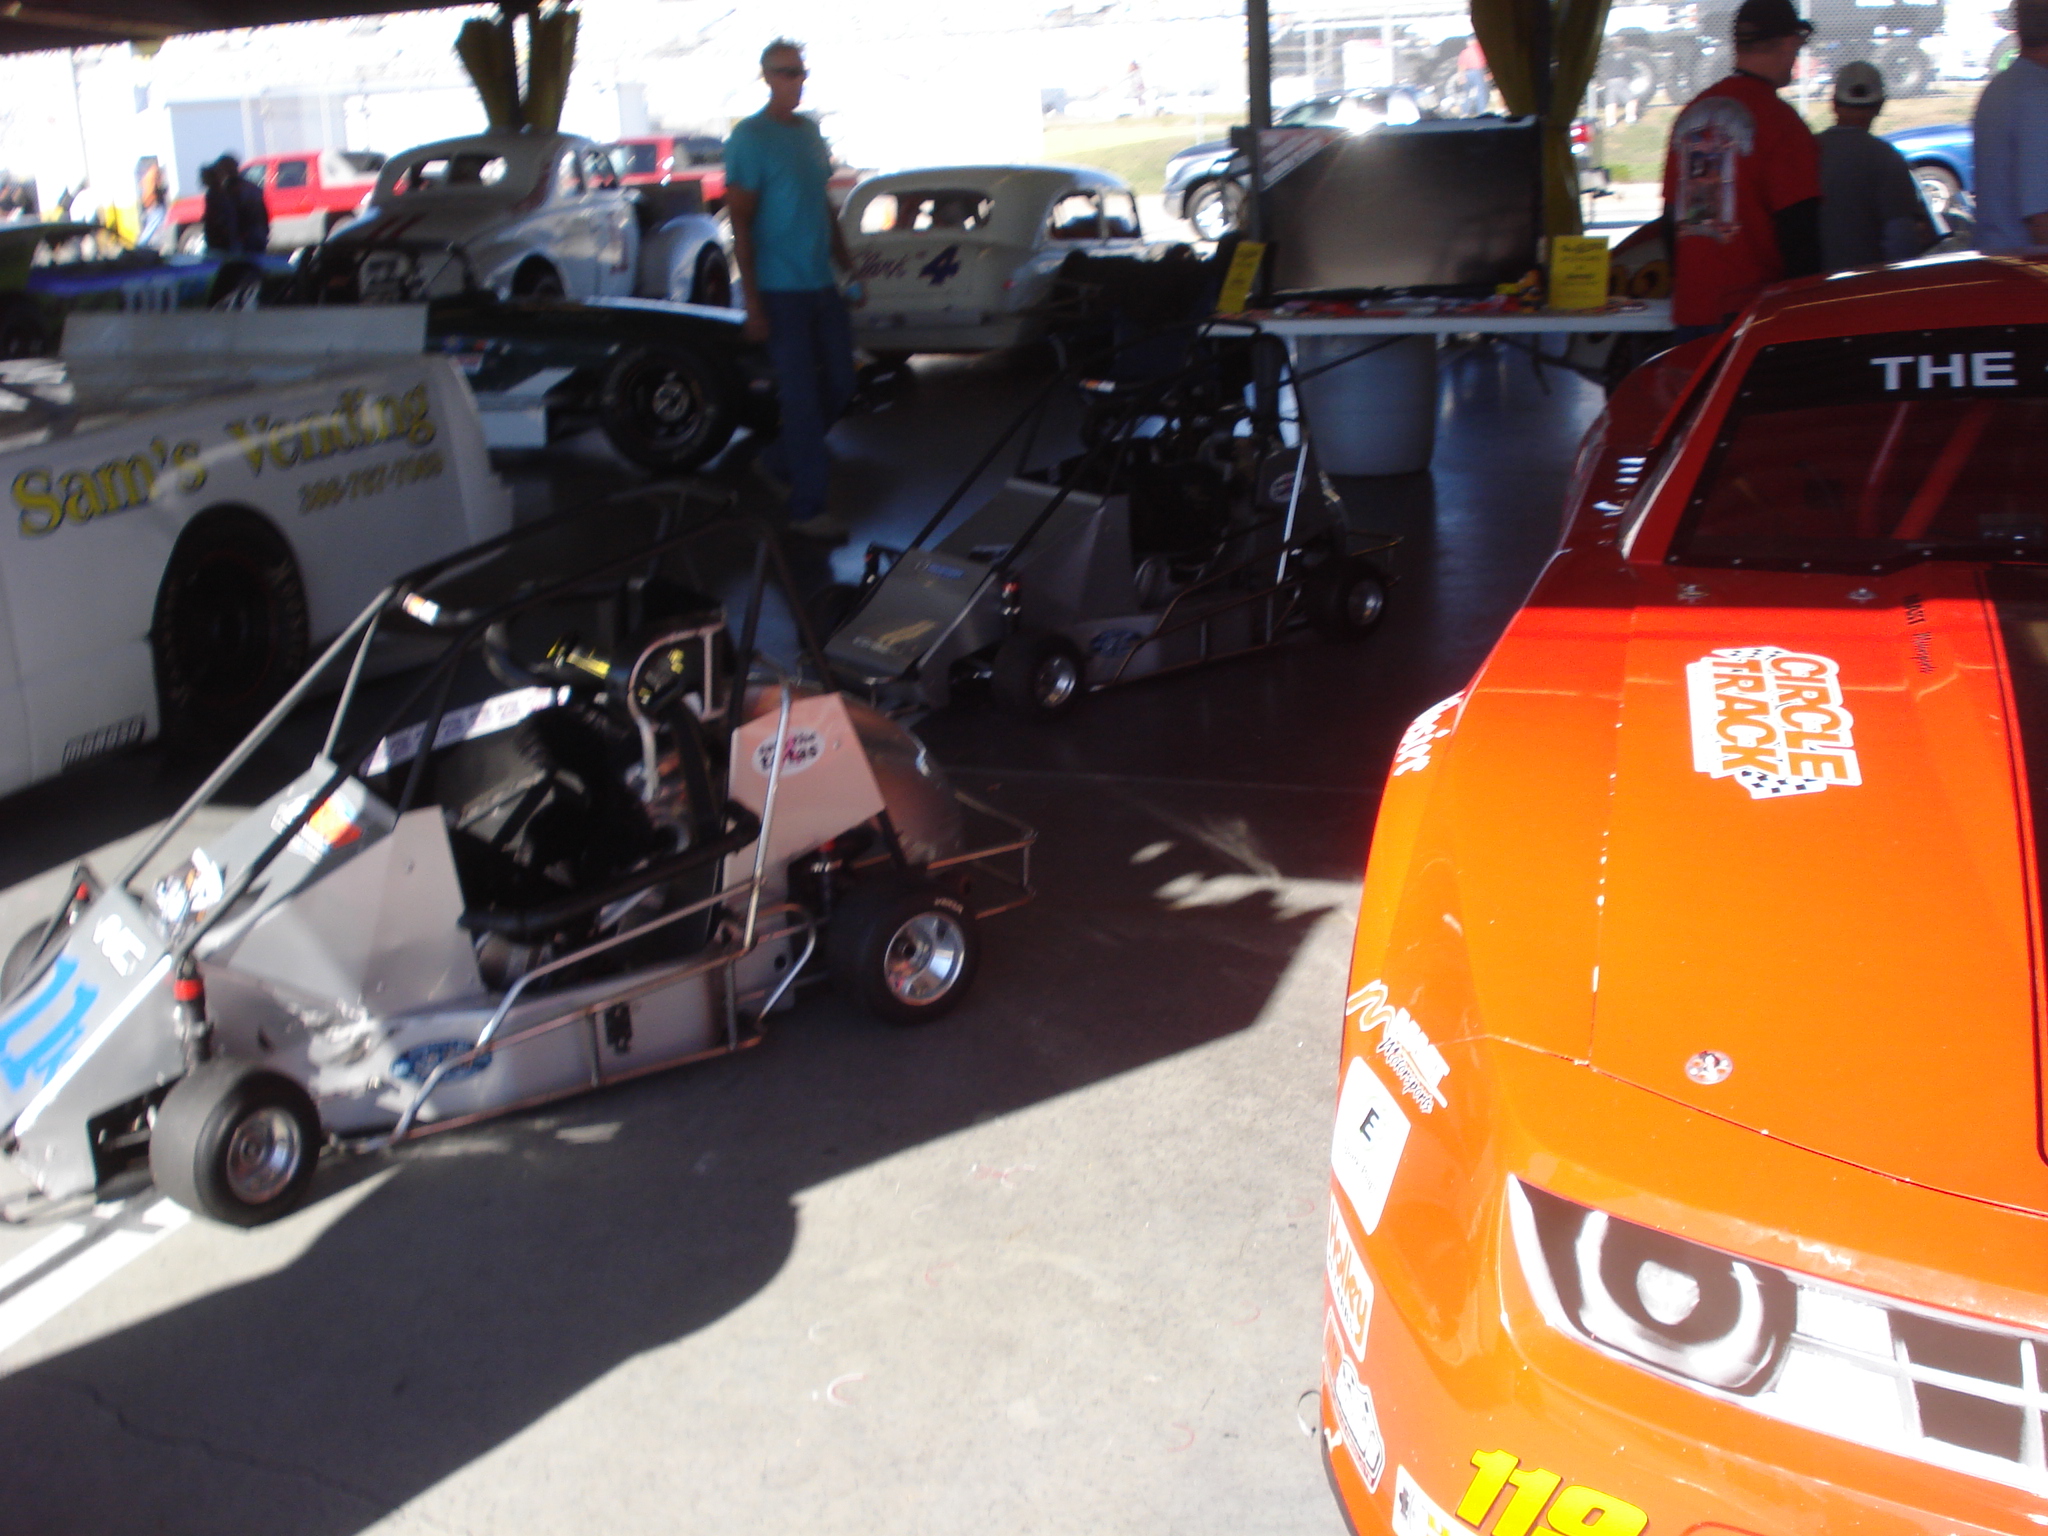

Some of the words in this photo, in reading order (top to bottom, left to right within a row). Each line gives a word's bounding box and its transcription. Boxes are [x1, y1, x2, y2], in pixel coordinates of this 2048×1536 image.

[917, 243, 960, 286] 4
[1870, 351, 2018, 391] THE
[12, 437, 207, 538] Sam's
[226, 384, 437, 478] Vending
[1711, 660, 1779, 776] TRACK
[1770, 657, 1849, 780] CIRCLE
[1376, 1036, 1435, 1113] Motorsports
[1359, 1106, 1381, 1141] E
[1455, 1448, 1650, 1536] 119
